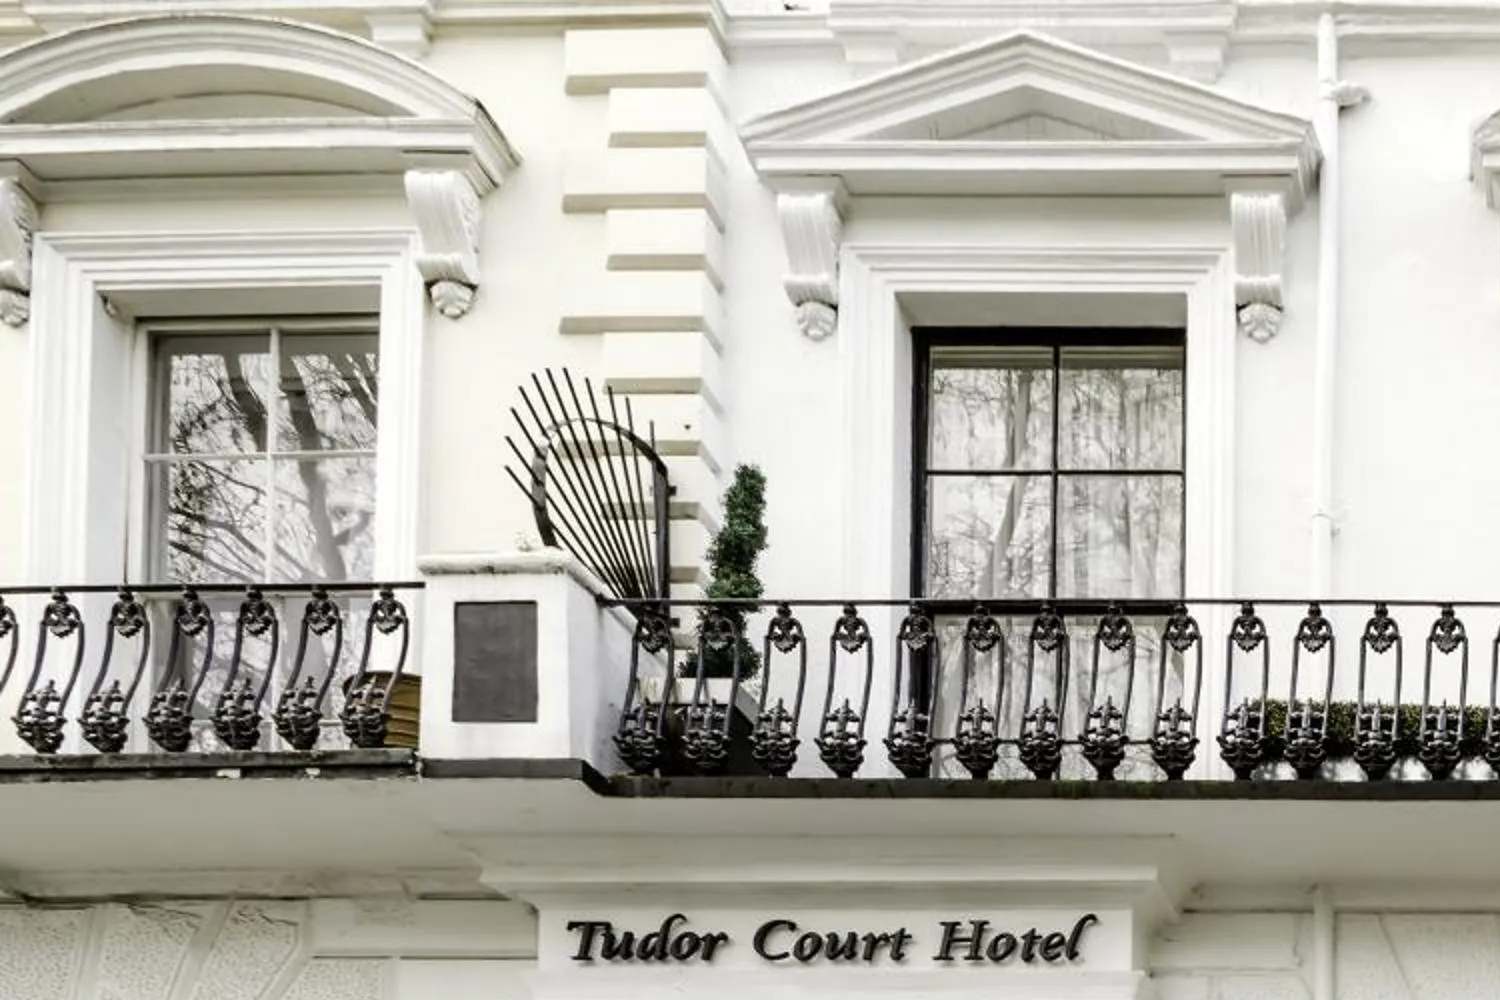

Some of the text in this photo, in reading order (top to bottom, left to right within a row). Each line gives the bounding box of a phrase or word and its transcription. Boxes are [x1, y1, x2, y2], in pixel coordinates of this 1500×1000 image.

[566, 913, 1099, 963] Tudor Court Hotel
